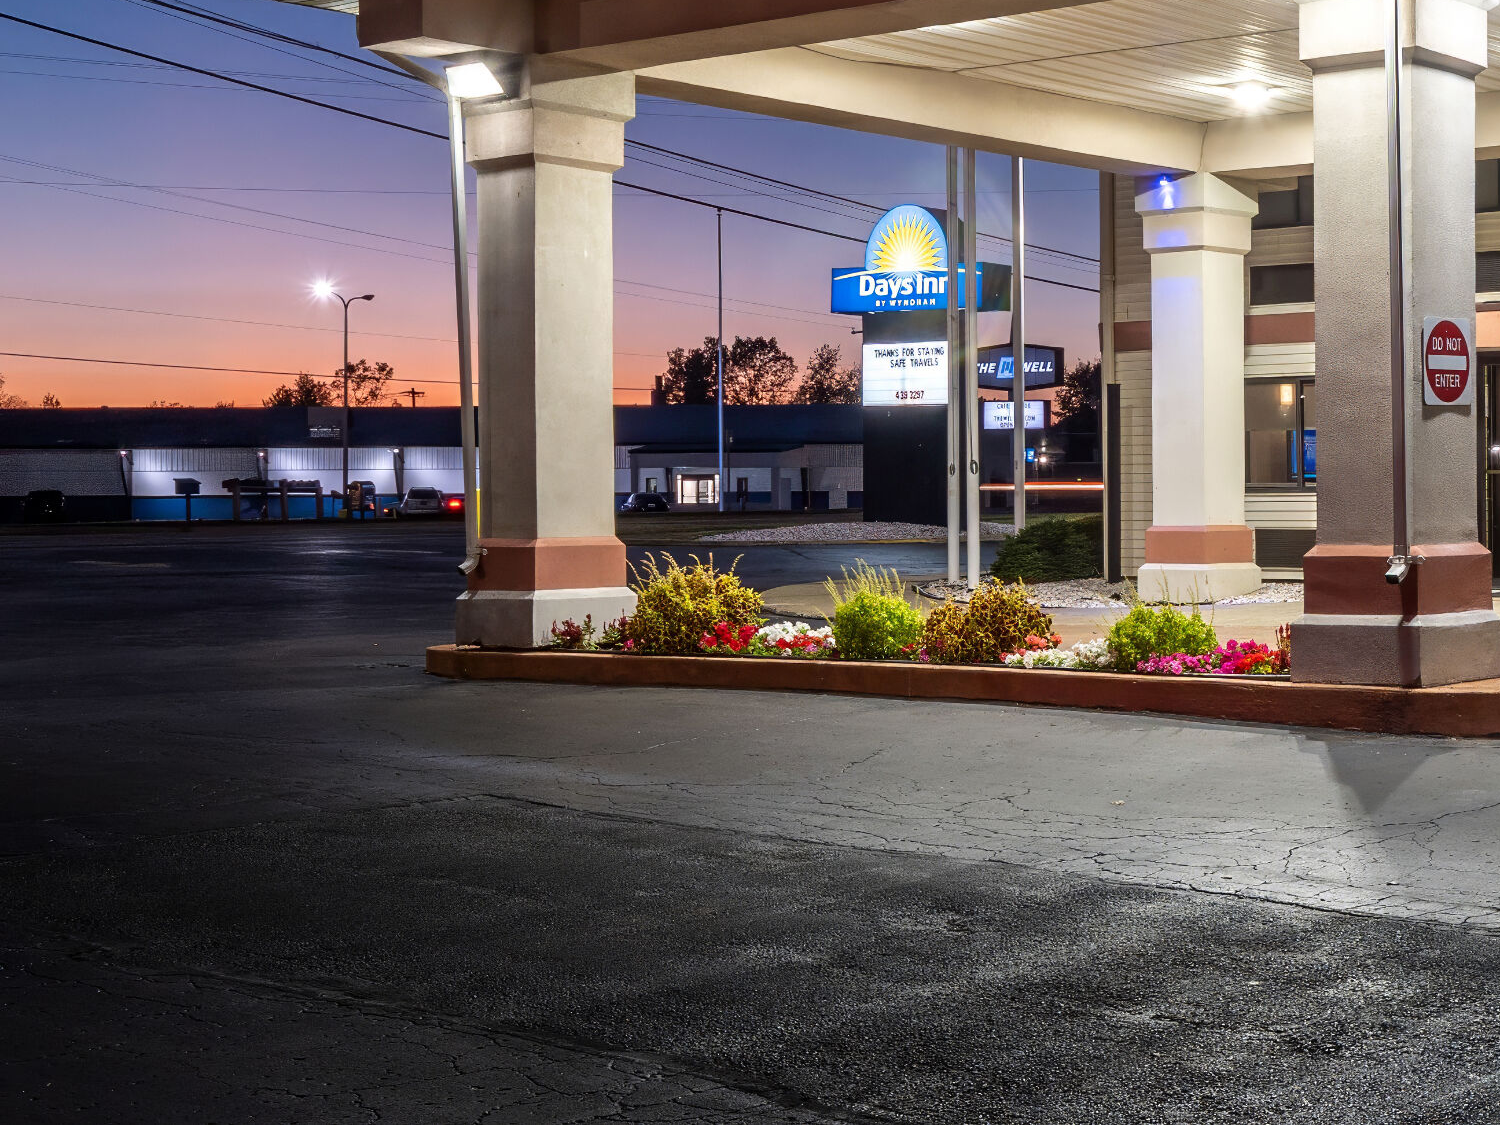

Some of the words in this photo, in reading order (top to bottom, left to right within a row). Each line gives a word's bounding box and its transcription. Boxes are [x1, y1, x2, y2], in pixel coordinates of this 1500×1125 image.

[859, 275, 914, 299] Days
[889, 298, 936, 306] WYNDHAM
[1432, 337, 1443, 350] DO
[1446, 338, 1461, 351] NOT
[874, 348, 899, 358] THANKS
[902, 347, 915, 356] FOR
[917, 346, 945, 356] STAYING
[890, 359, 906, 368] SAFE
[910, 357, 939, 367] TRAVELS
[1435, 374, 1460, 387] ENTER
